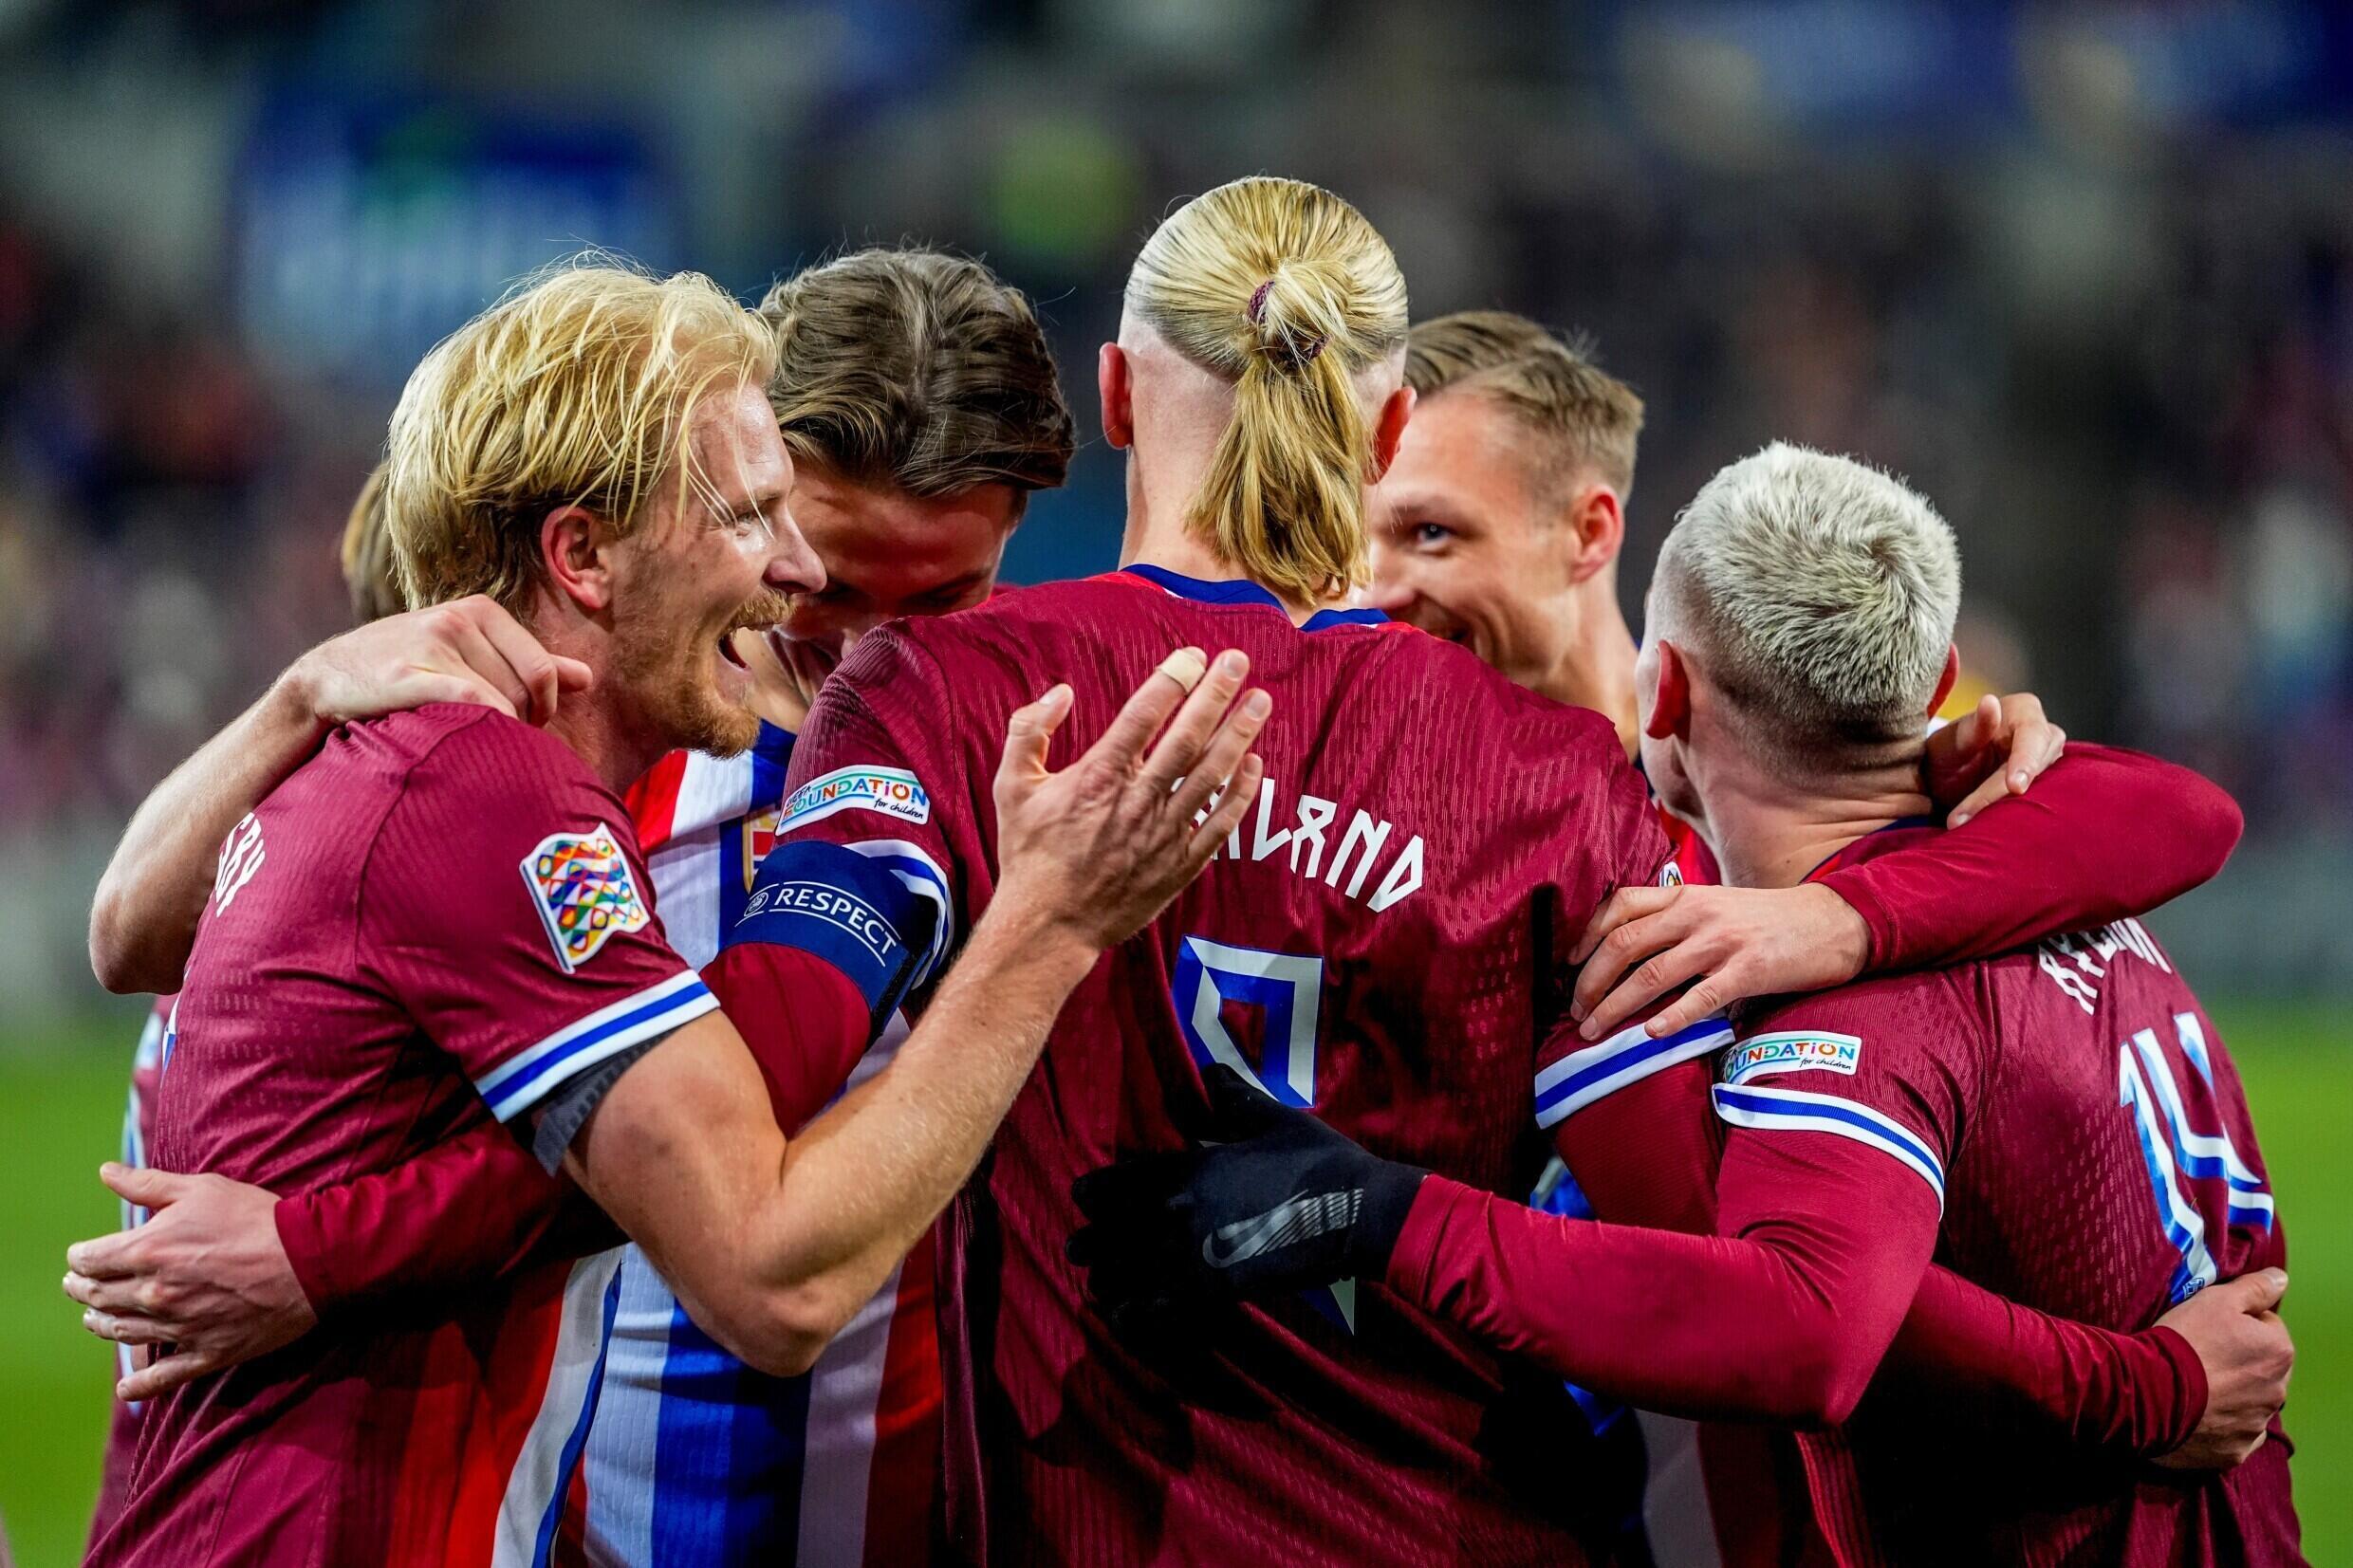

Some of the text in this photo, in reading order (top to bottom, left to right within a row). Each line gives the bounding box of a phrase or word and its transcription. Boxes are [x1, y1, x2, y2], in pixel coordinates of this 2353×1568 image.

[784, 778, 927, 819] FOUNDATION
[874, 798, 924, 820] for children
[1171, 775, 1424, 913] LAND
[773, 888, 898, 955] RESPECT
[1724, 1042, 1856, 1080] OUNDATION
[1799, 1058, 1852, 1070] for children
[2119, 1011, 2275, 1303] 14
